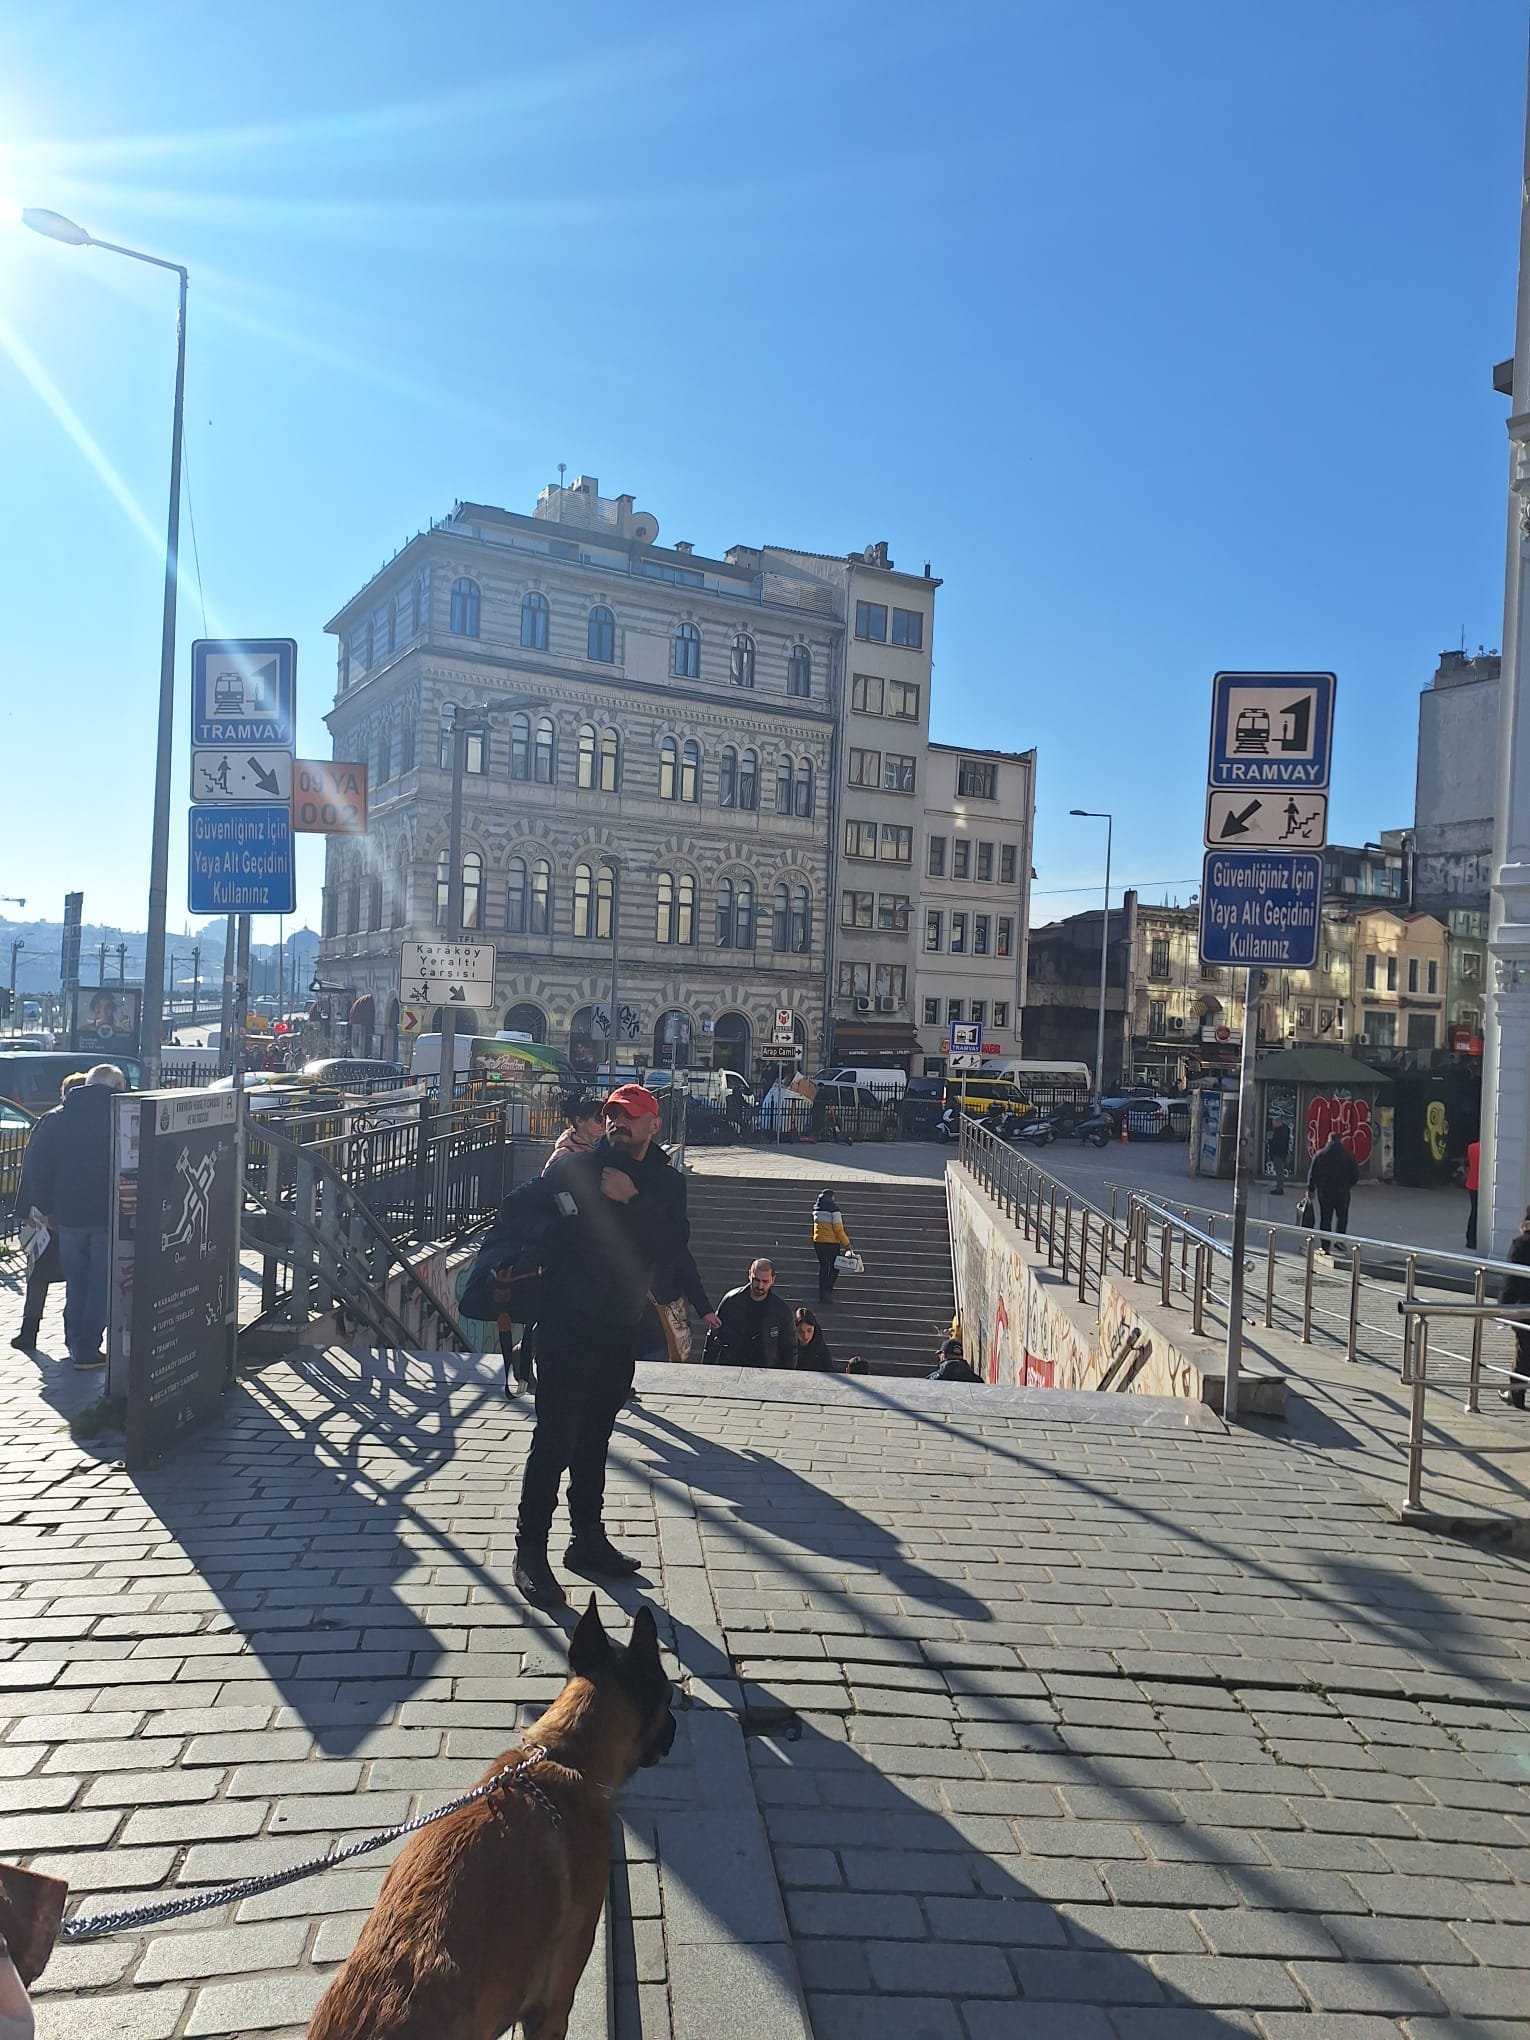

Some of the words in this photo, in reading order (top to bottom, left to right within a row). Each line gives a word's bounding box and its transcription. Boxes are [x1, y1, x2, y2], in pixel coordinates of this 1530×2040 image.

[200, 724, 286, 740] TRAMVAY
[300, 771, 323, 793] 09
[331, 772, 360, 796] YA
[1219, 763, 1320, 781] TRAMVAY
[301, 803, 359, 827] 002
[267, 811, 288, 846] İçin
[194, 850, 221, 879] Yaya
[223, 851, 239, 873] Alt
[242, 850, 288, 879] Geçidini
[1213, 861, 1289, 895] Güvenliğiniz
[1291, 858, 1314, 896] İçin
[213, 881, 269, 905] Kullanınız
[1209, 898, 1238, 930] Yaya
[1241, 900, 1260, 927] Alt
[1263, 899, 1315, 932] Geçidini
[416, 944, 480, 958] Karaköy
[1229, 932, 1290, 959] Kullanınız
[420, 956, 475, 967] Yeraltı
[420, 967, 475, 978] Çarşısı
[763, 1047, 778, 1057] Arap
